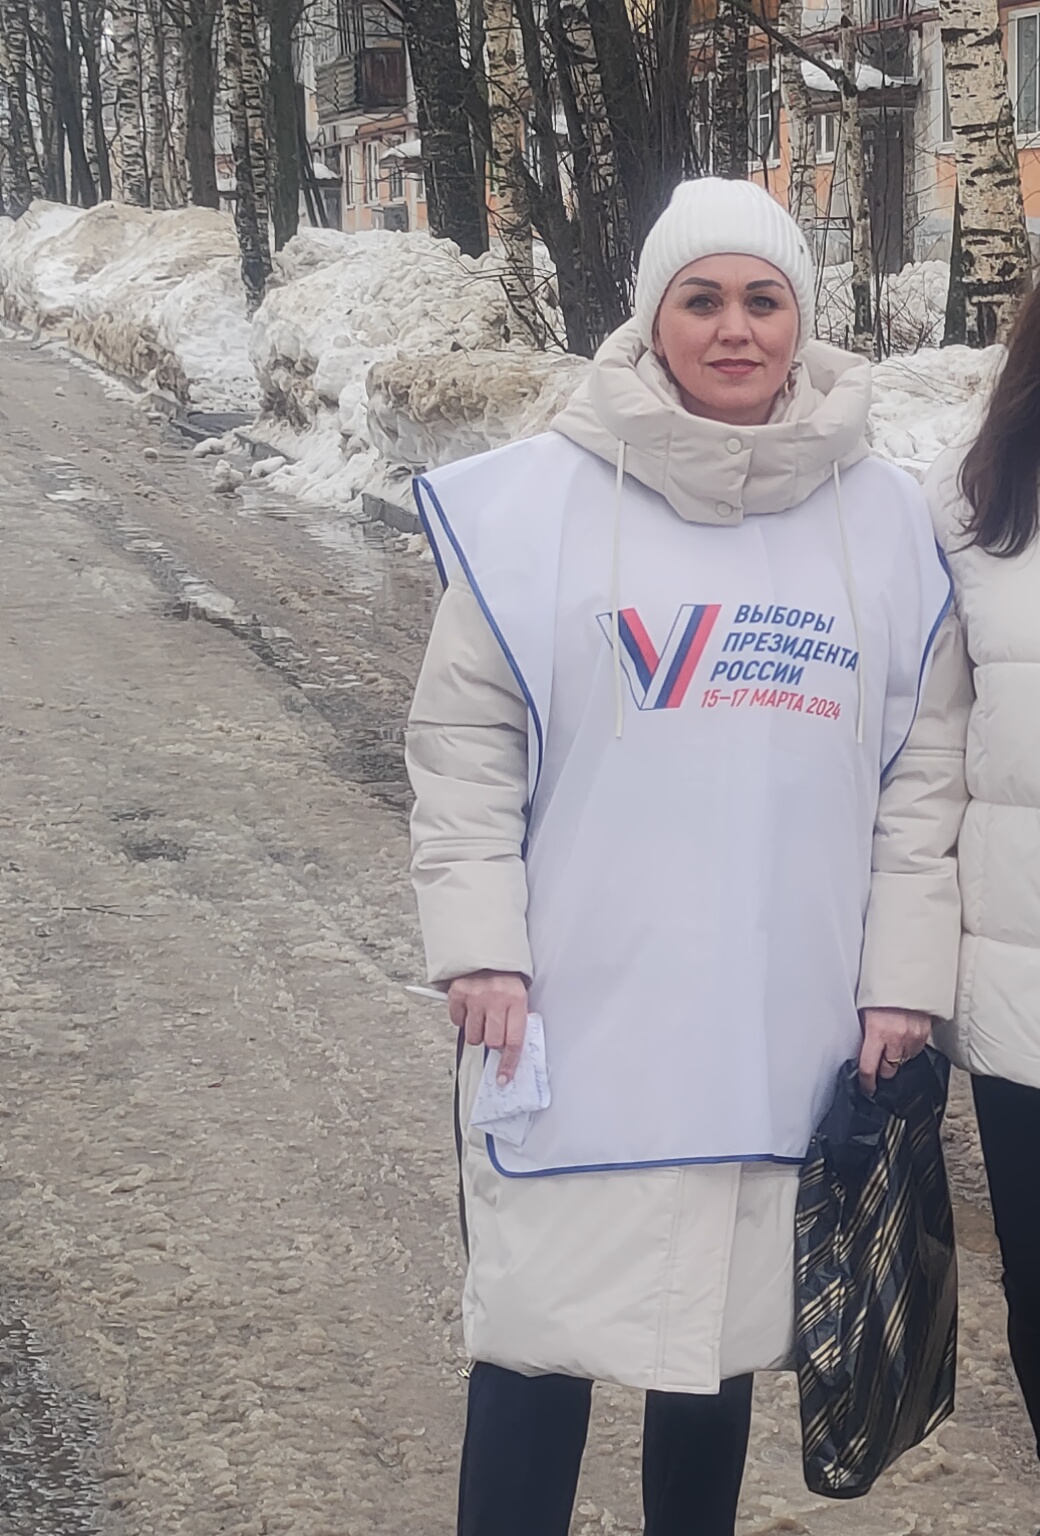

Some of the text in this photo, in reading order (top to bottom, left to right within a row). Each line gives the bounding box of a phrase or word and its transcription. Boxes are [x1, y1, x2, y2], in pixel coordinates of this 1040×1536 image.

[733, 603, 835, 635] ВЫБОРЫ
[721, 631, 860, 672] ПРЕЗИДЕНТА
[709, 660, 805, 686] РОССИИ
[749, 687, 804, 713] МАРТА
[805, 696, 842, 721] 2024
